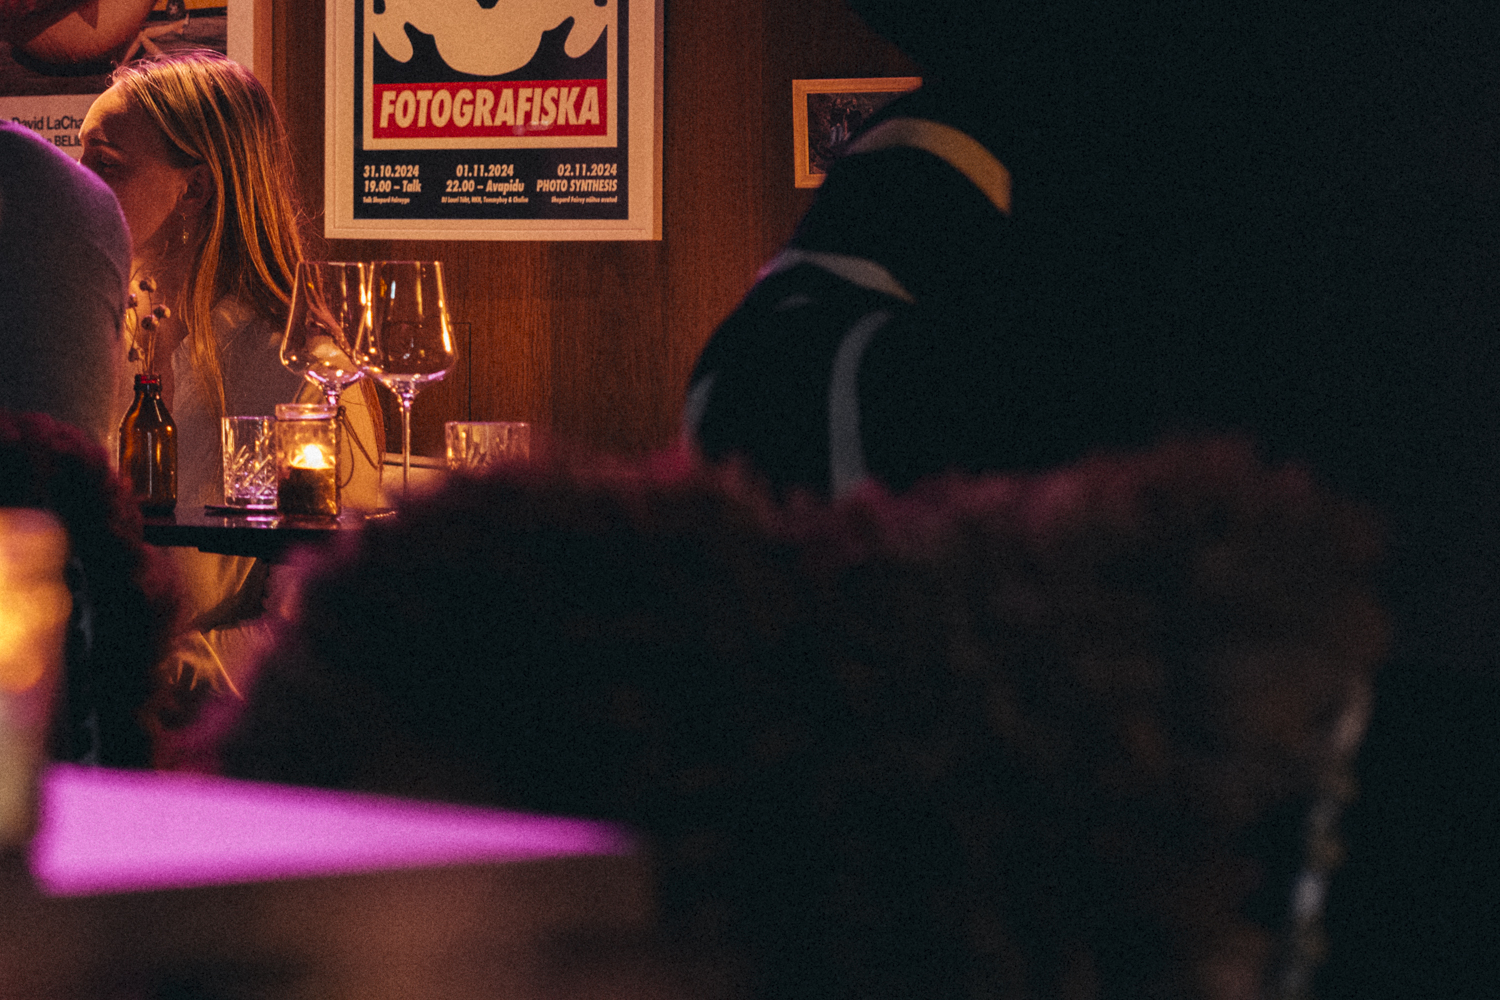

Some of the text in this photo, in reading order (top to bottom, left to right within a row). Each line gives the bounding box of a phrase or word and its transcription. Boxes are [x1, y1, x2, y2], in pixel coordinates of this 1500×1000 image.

[379, 86, 600, 128] FOTOGRAFISKA
[363, 164, 420, 178] 31.10.2024
[456, 163, 514, 177] 01.11.2024
[557, 163, 617, 177] 02.11.2024
[364, 179, 392, 193] 19.00
[402, 179, 422, 193] Talk
[445, 179, 475, 193] 22.00
[485, 178, 525, 196] Avapidu
[536, 178, 617, 192] PHOTO SYNTHESIS
